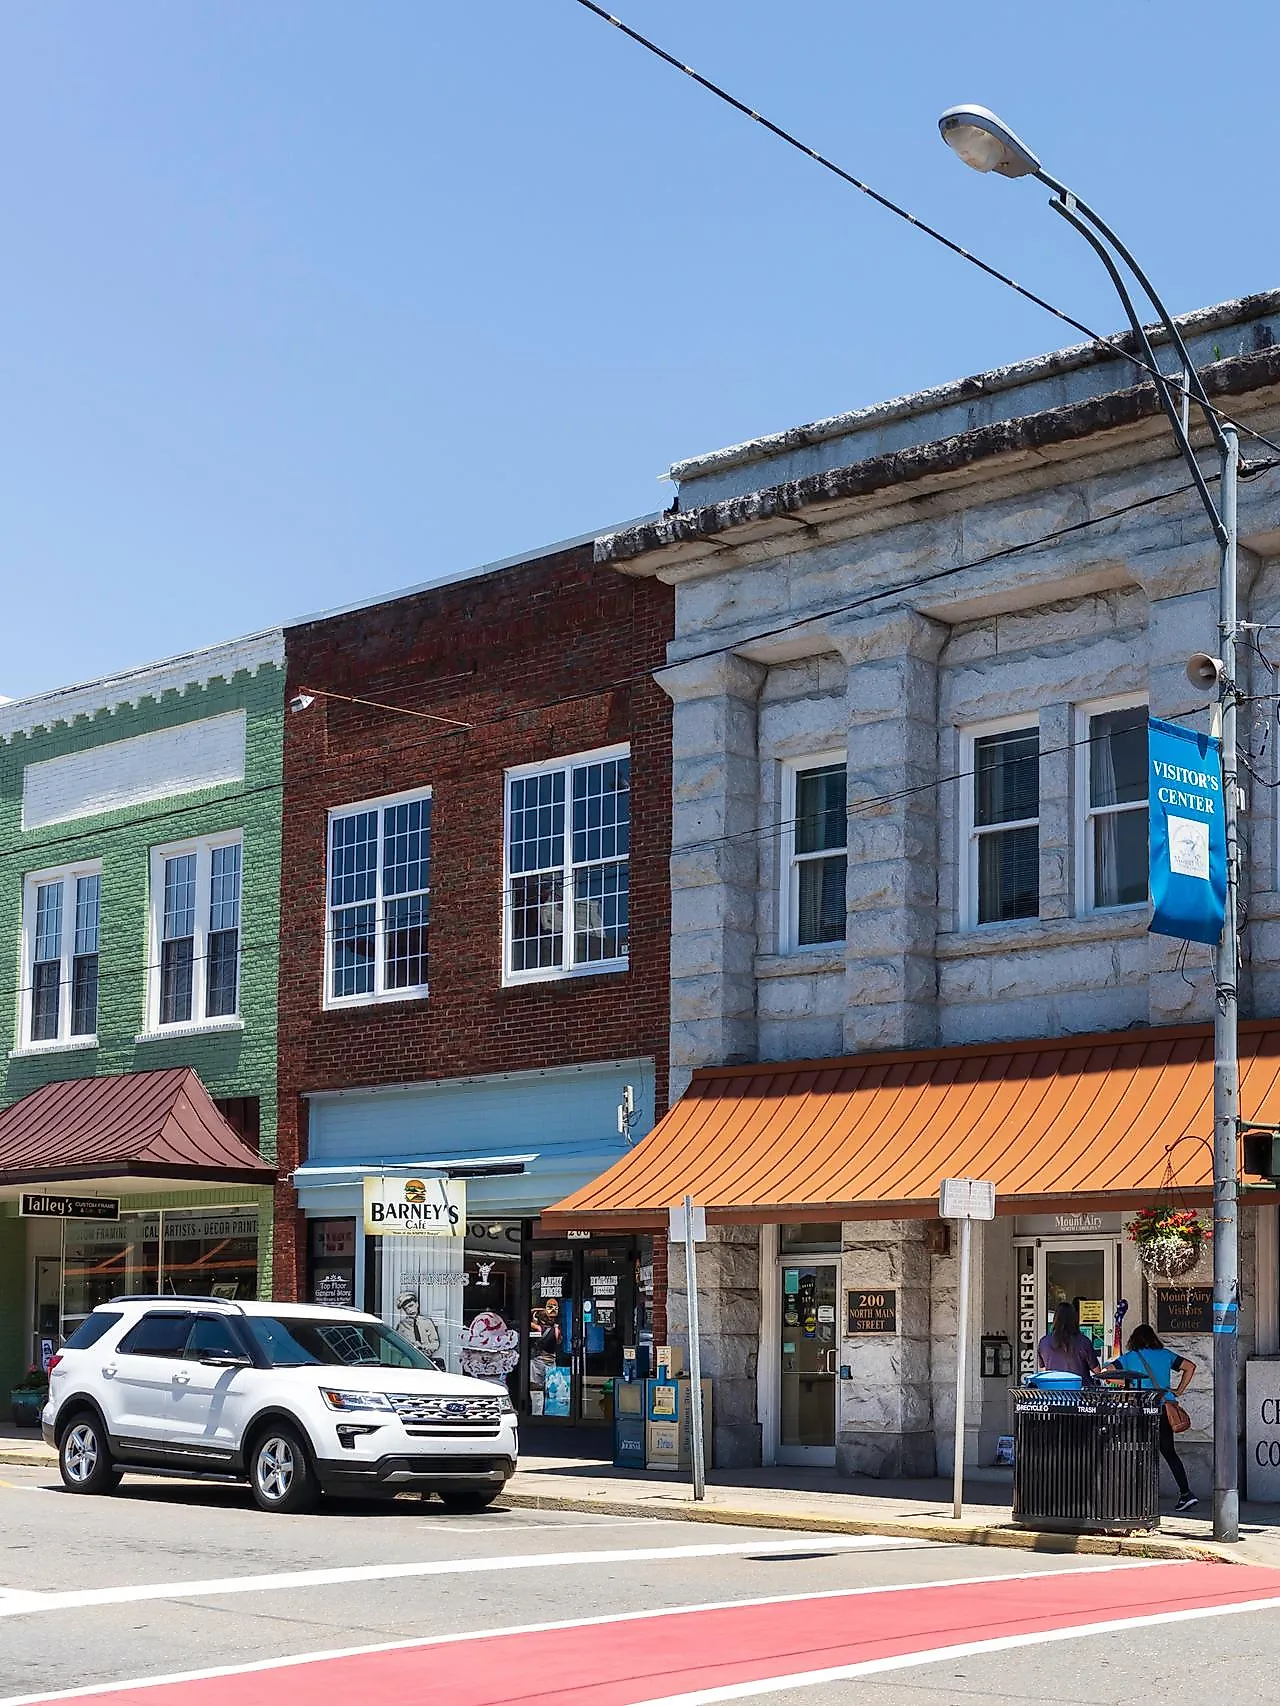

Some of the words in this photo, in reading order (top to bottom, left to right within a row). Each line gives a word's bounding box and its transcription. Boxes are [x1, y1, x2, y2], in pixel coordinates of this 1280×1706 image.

[1153, 760, 1219, 791] VISITOR'S
[1158, 787, 1215, 814] CENTER
[26, 1195, 73, 1215] Talley's
[371, 1202, 459, 1225] BARNEY'S
[1055, 1215, 1082, 1227] Mount
[1084, 1214, 1102, 1229] Airy
[164, 1222, 196, 1238] ARTISTS
[319, 1282, 331, 1291] Top
[315, 1289, 336, 1297] General
[1191, 1292, 1212, 1304] Airy
[860, 1294, 885, 1307] 200
[849, 1308, 873, 1319] NORTH
[874, 1308, 895, 1318] MAIN
[1020, 1273, 1035, 1344] CENTER
[856, 1320, 885, 1330] STREET
[1170, 1318, 1201, 1329] Center
[1020, 1404, 1044, 1412] RECYCLE
[1077, 1406, 1097, 1414] TRASH
[1143, 1407, 1159, 1415] TRASH
